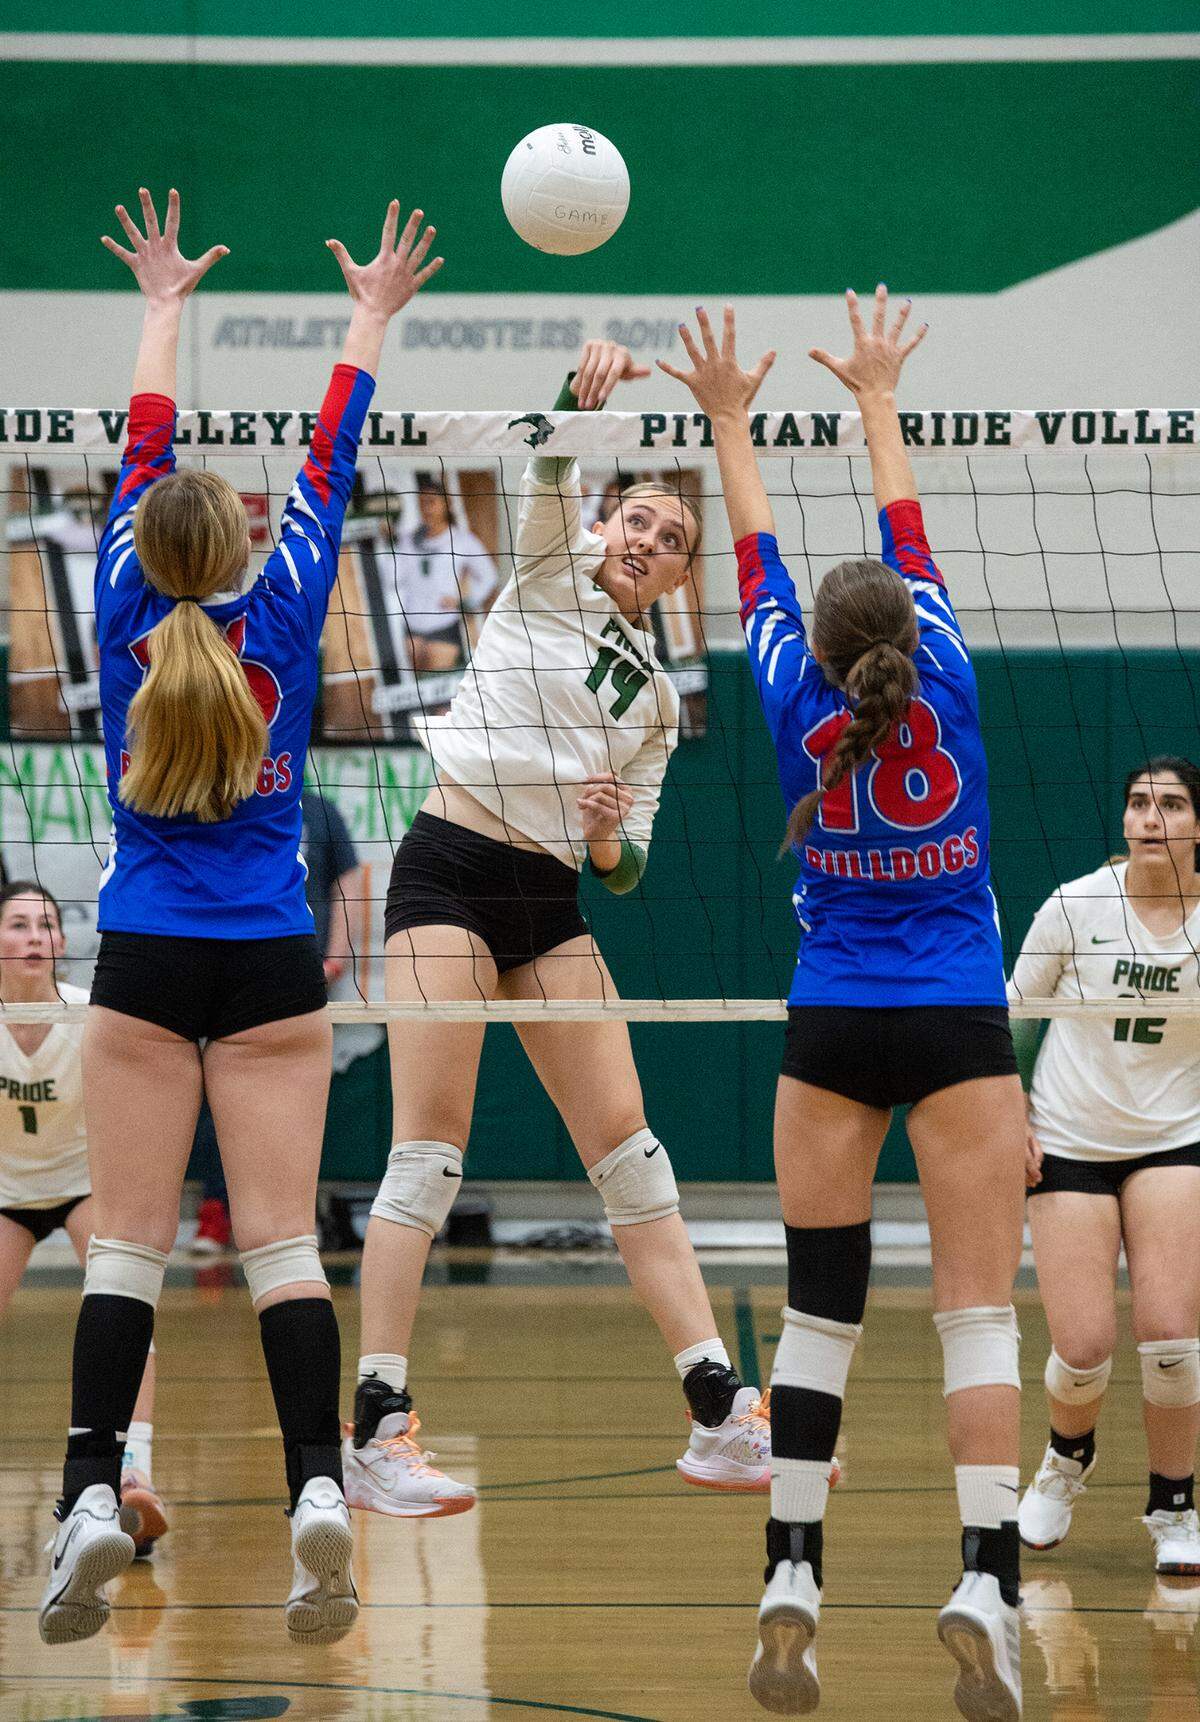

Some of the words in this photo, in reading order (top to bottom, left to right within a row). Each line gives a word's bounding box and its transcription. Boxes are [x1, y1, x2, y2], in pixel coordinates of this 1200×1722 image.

[554, 204, 610, 225] GAME
[213, 315, 351, 347] ATHLET
[864, 411, 1011, 446] RIDE
[1035, 409, 1194, 444] VOLLE
[801, 696, 963, 834] 18
[1112, 958, 1182, 994] PRIDE
[18, 1105, 38, 1134] 1
